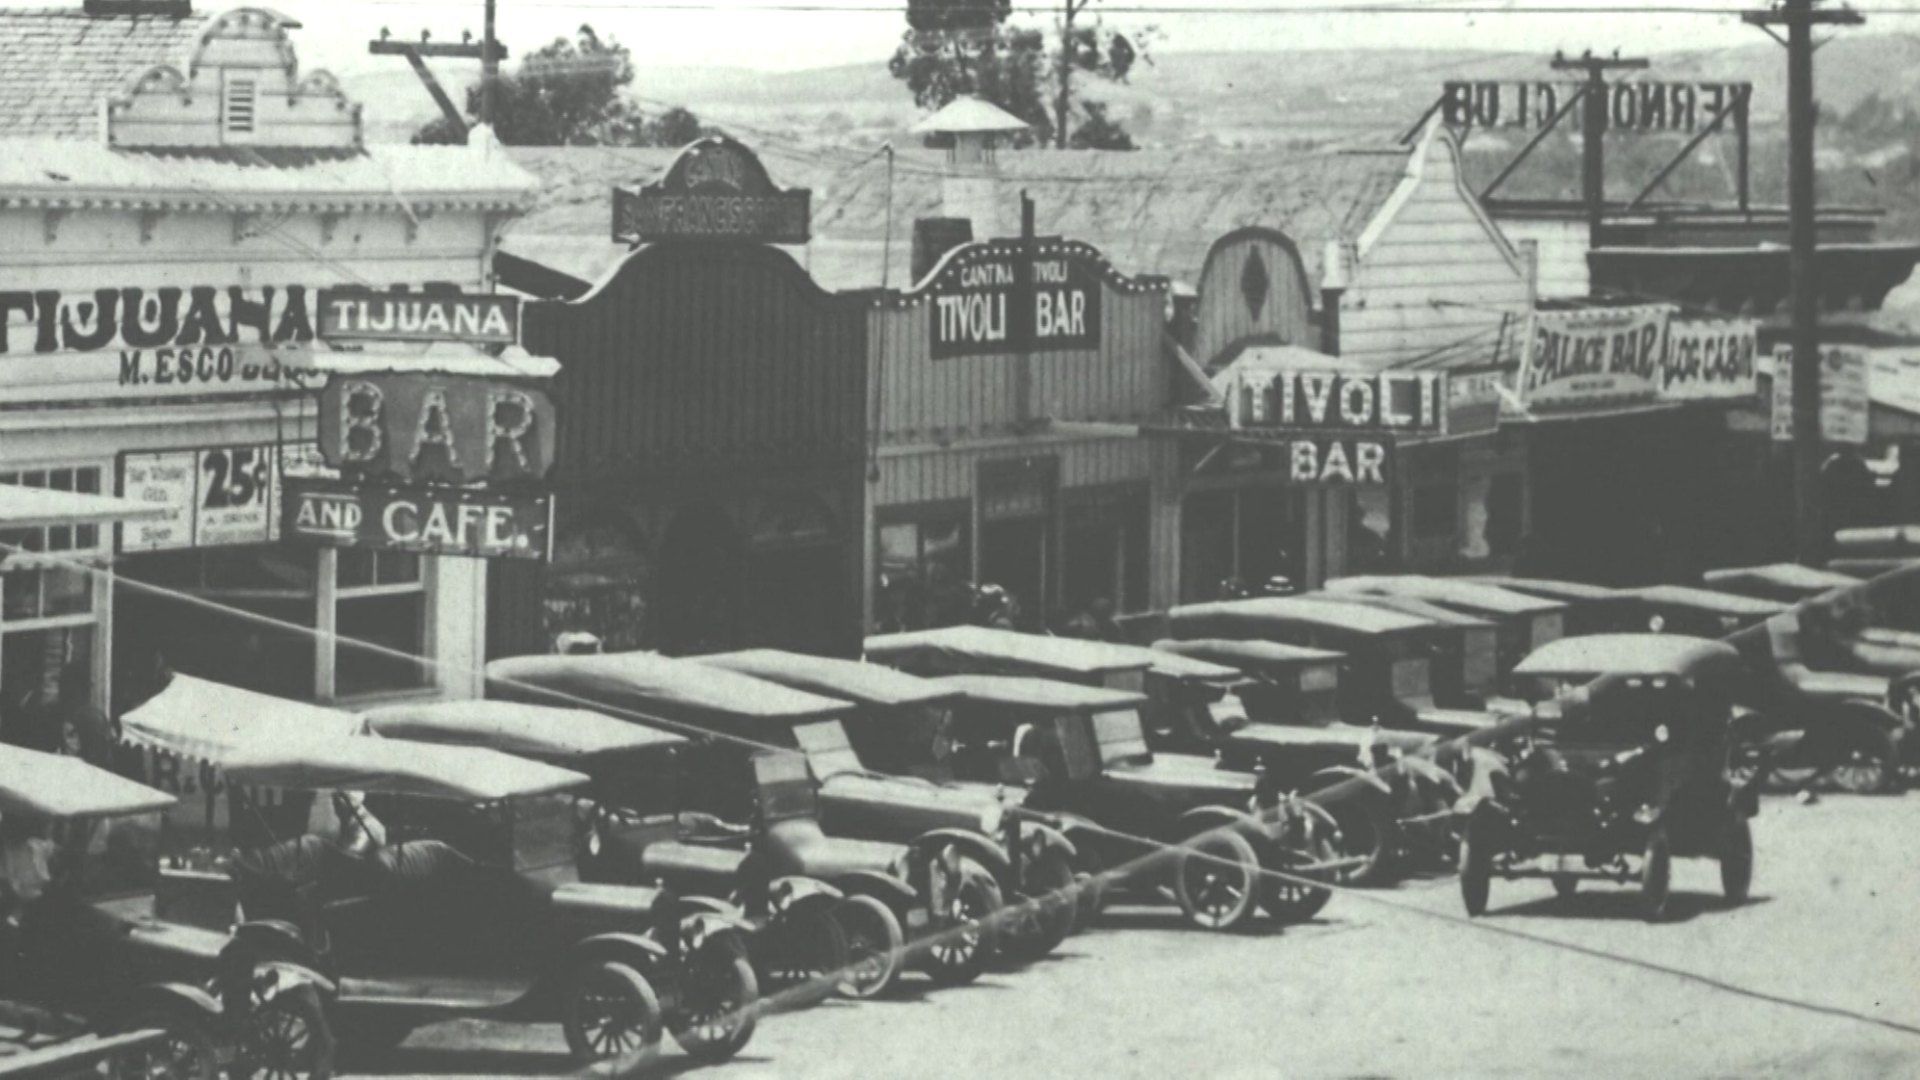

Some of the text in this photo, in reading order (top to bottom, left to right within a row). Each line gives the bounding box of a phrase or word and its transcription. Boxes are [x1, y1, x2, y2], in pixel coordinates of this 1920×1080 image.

[1033, 261, 1068, 282] TIVOLI
[331, 300, 510, 336] TIJUANA
[937, 290, 1086, 342] TIVOLI BAR
[1241, 370, 1439, 426] TIVOLI
[340, 381, 533, 471] BAR
[203, 450, 268, 508] 25¢
[1291, 440, 1385, 484] BAR
[297, 499, 530, 549] AND CAFE.
